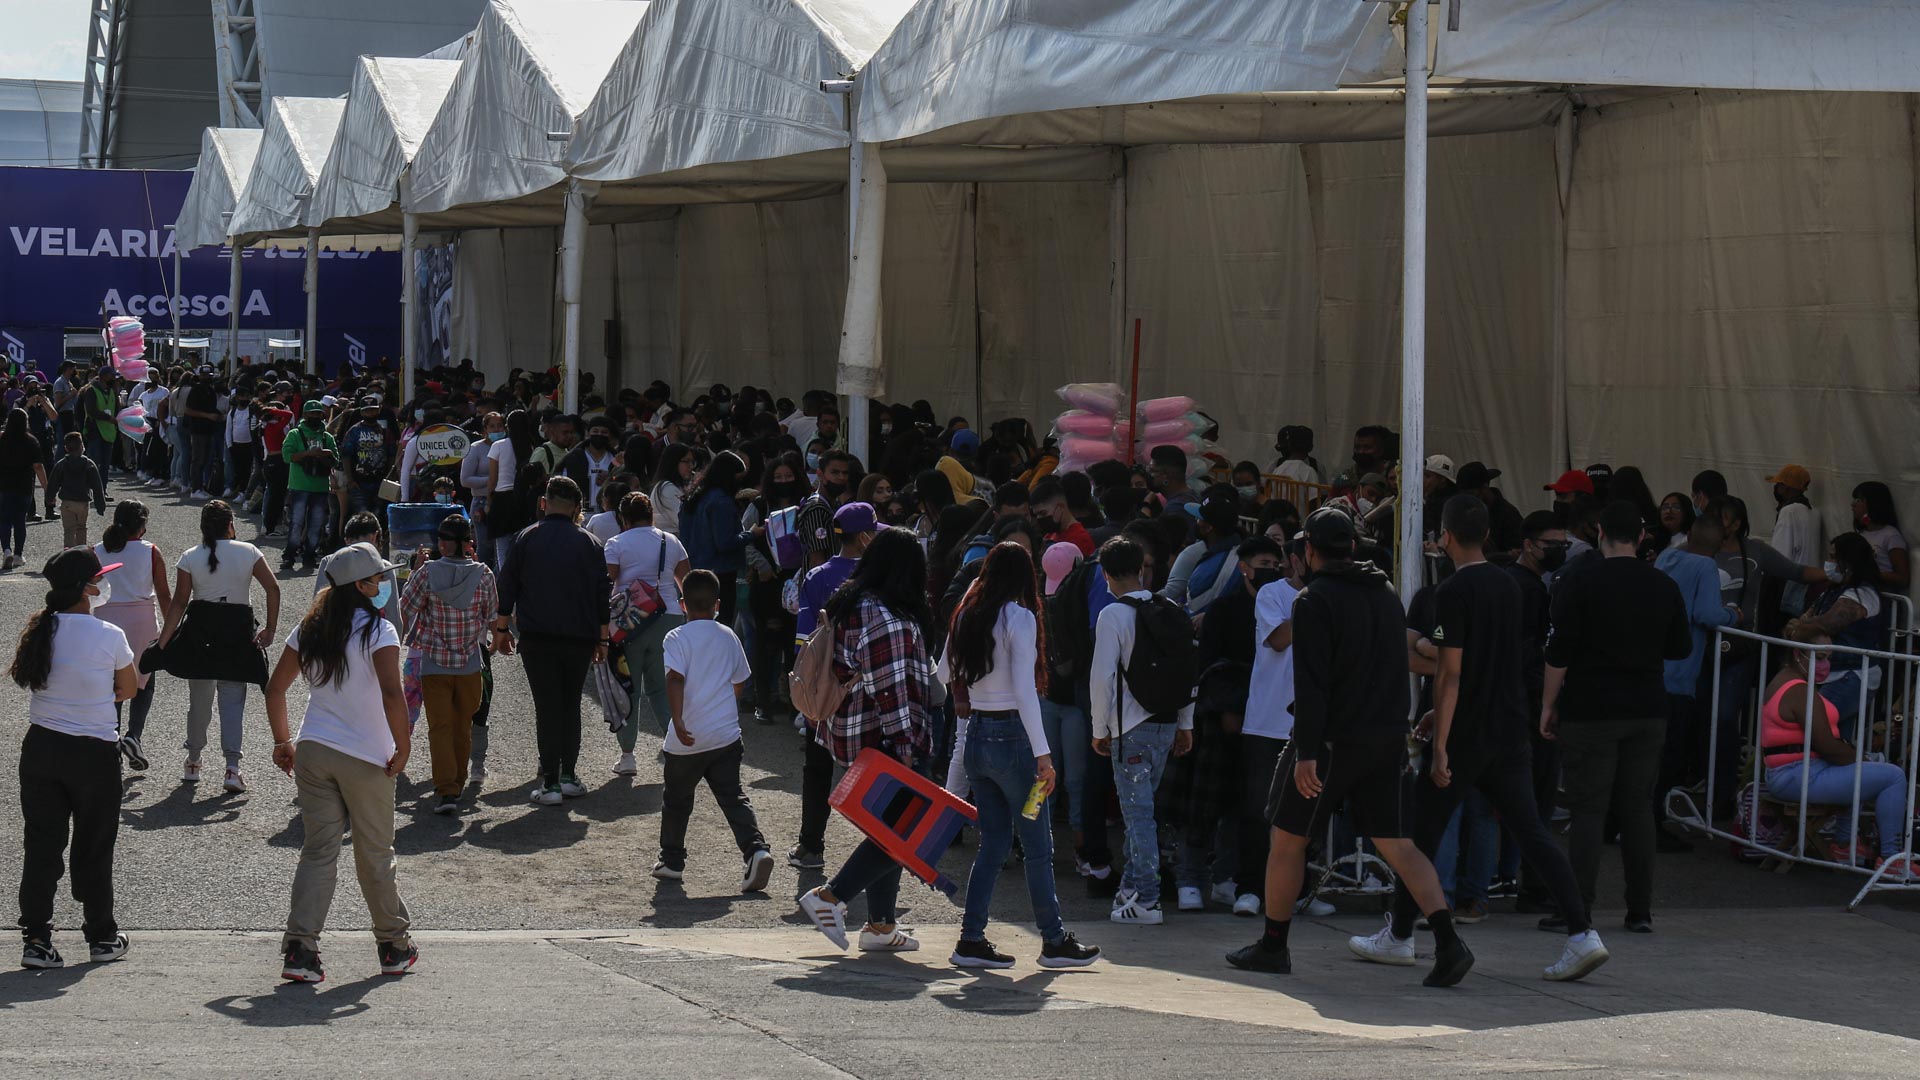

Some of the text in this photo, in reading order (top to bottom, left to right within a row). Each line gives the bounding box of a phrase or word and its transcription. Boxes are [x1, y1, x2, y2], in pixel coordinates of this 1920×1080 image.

[98, 288, 271, 316] Acceso A
[420, 441, 448, 450] UNICEL
